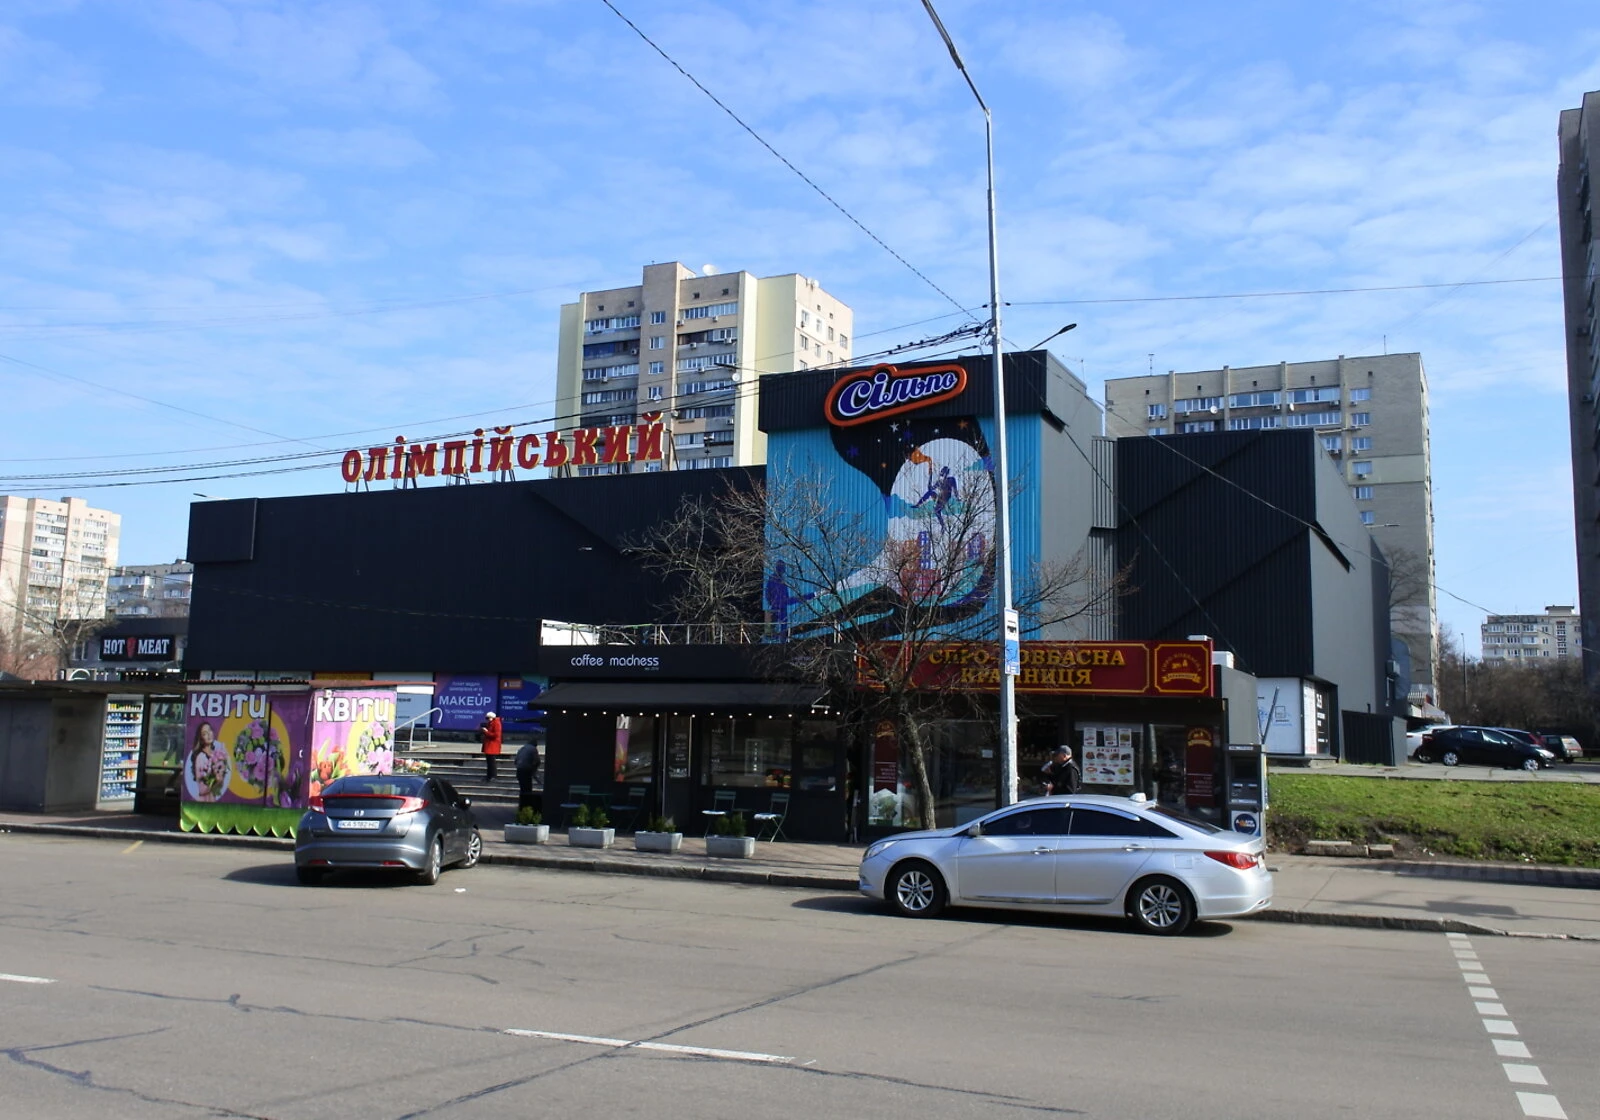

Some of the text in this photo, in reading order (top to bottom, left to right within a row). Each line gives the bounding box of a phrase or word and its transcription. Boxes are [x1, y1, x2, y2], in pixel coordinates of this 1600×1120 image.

[838, 372, 957, 416] Сільпо
[341, 411, 667, 483] ОЛІМПІЙСЬКИЙ
[103, 639, 170, 654] HOT MEAT
[570, 653, 660, 666] coffee madness
[928, 649, 1126, 666] СИРО-ОВБАСНА
[961, 667, 1093, 685] КРАНИЦЯ
[439, 693, 492, 706] MAKEUP
